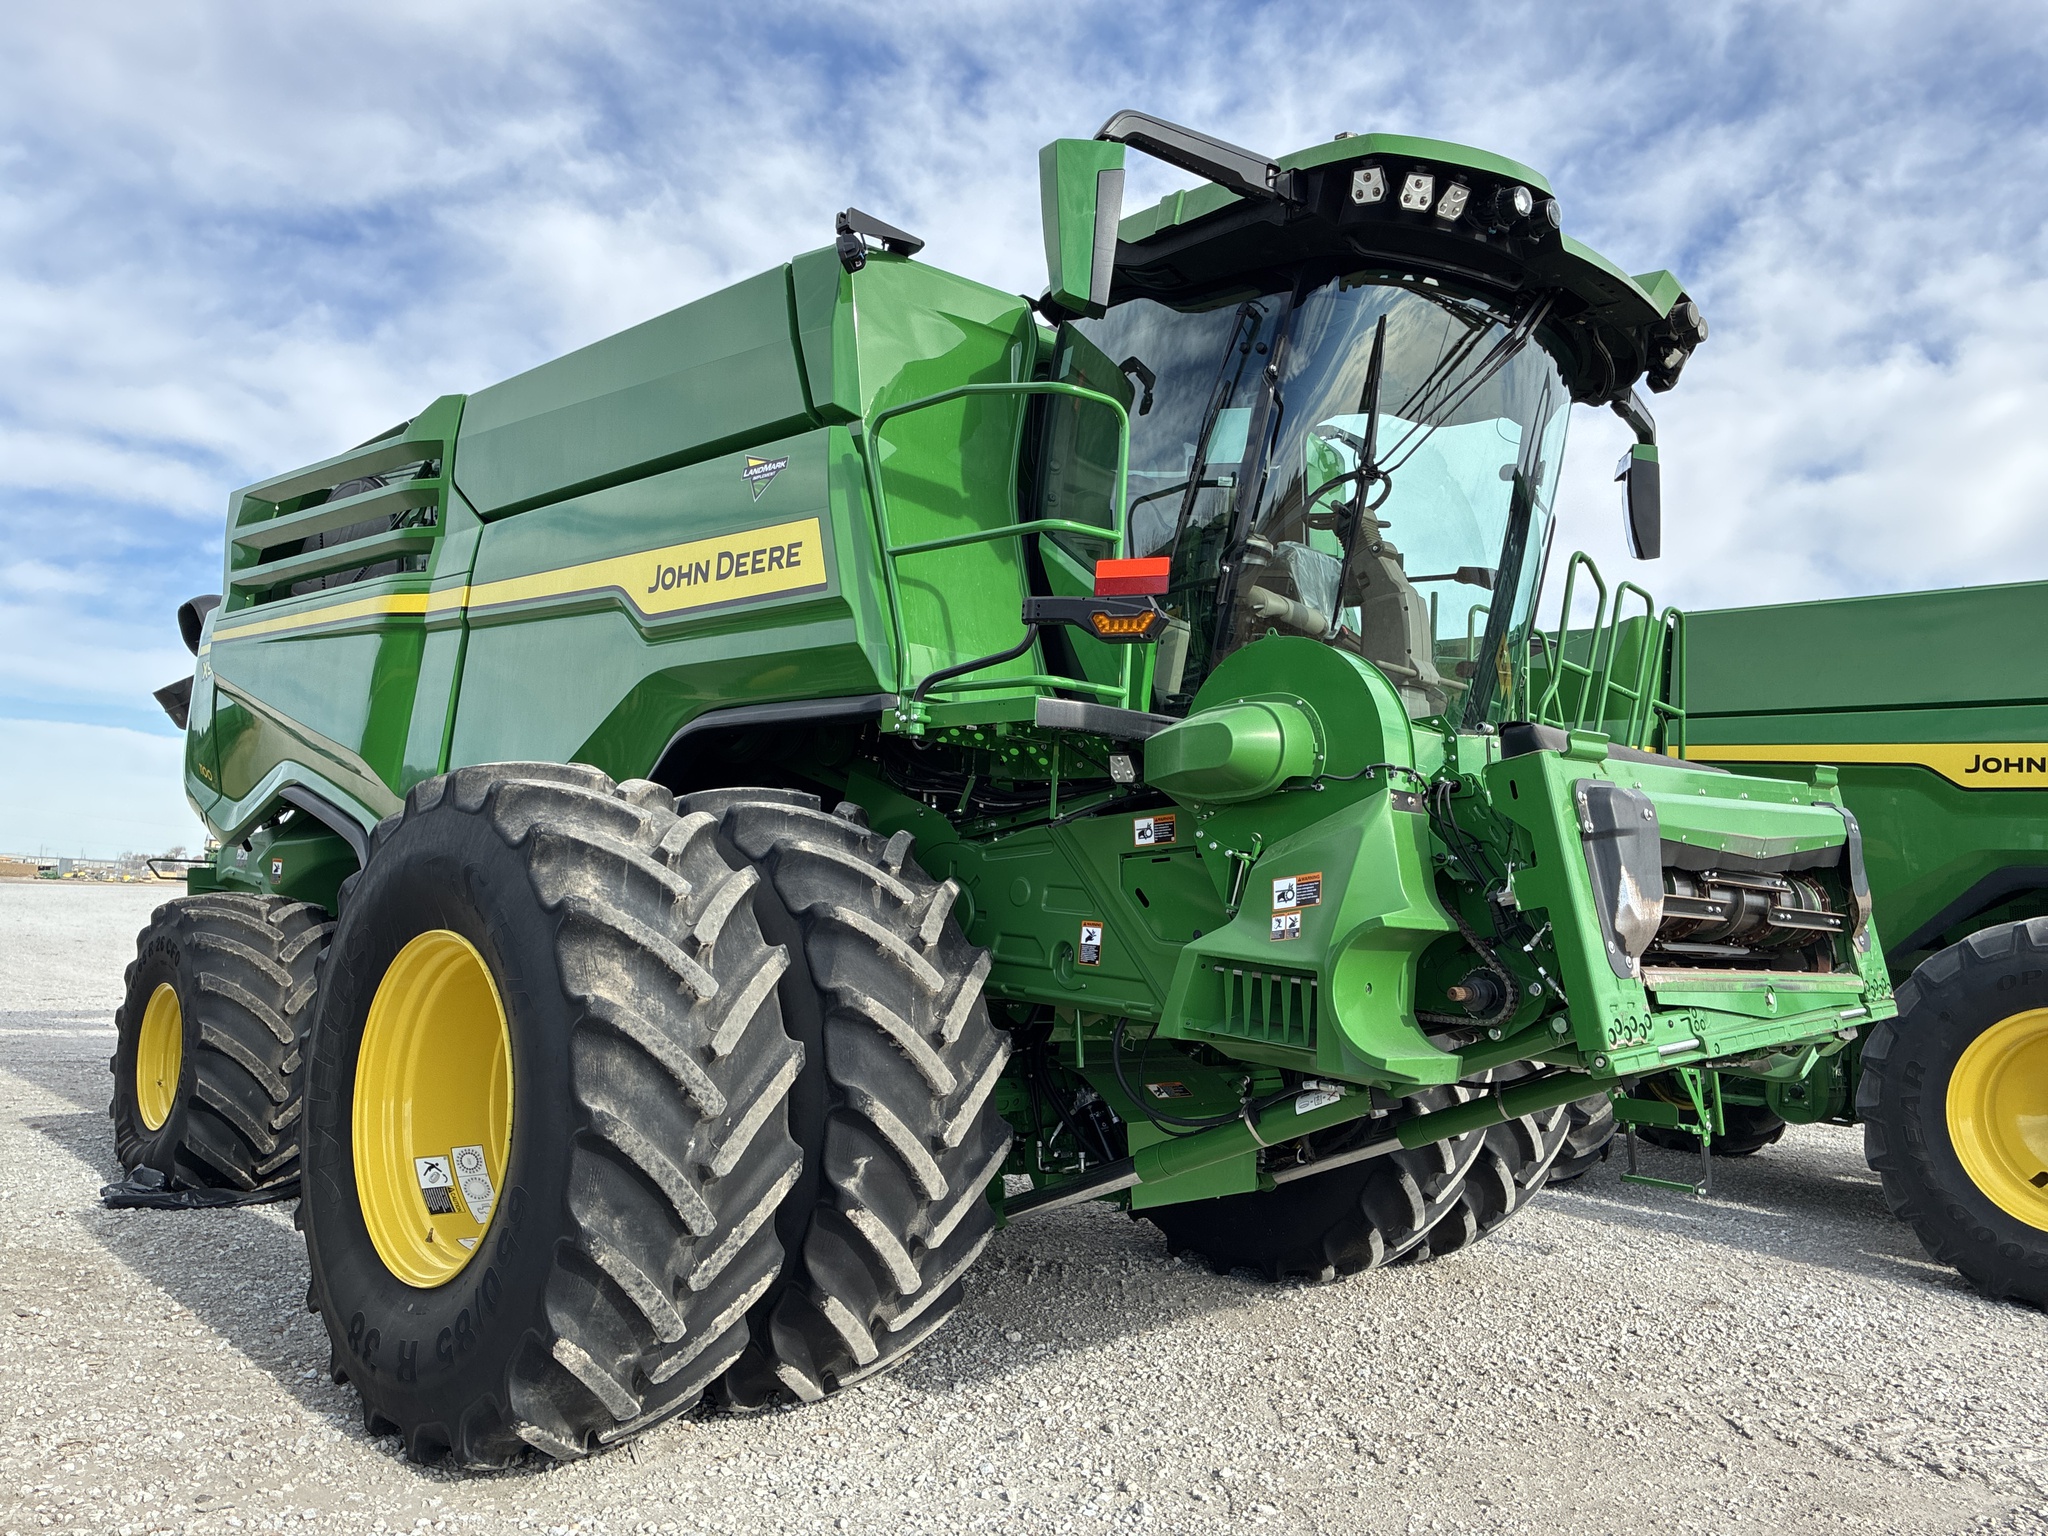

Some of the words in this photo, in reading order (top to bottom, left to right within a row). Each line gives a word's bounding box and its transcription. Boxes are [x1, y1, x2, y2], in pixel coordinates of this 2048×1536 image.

[648, 560, 710, 594] JOHN
[715, 541, 803, 581] DEERE
[1964, 754, 2046, 774] JOHN
[347, 1311, 382, 1377] 38
[397, 1339, 420, 1385] R
